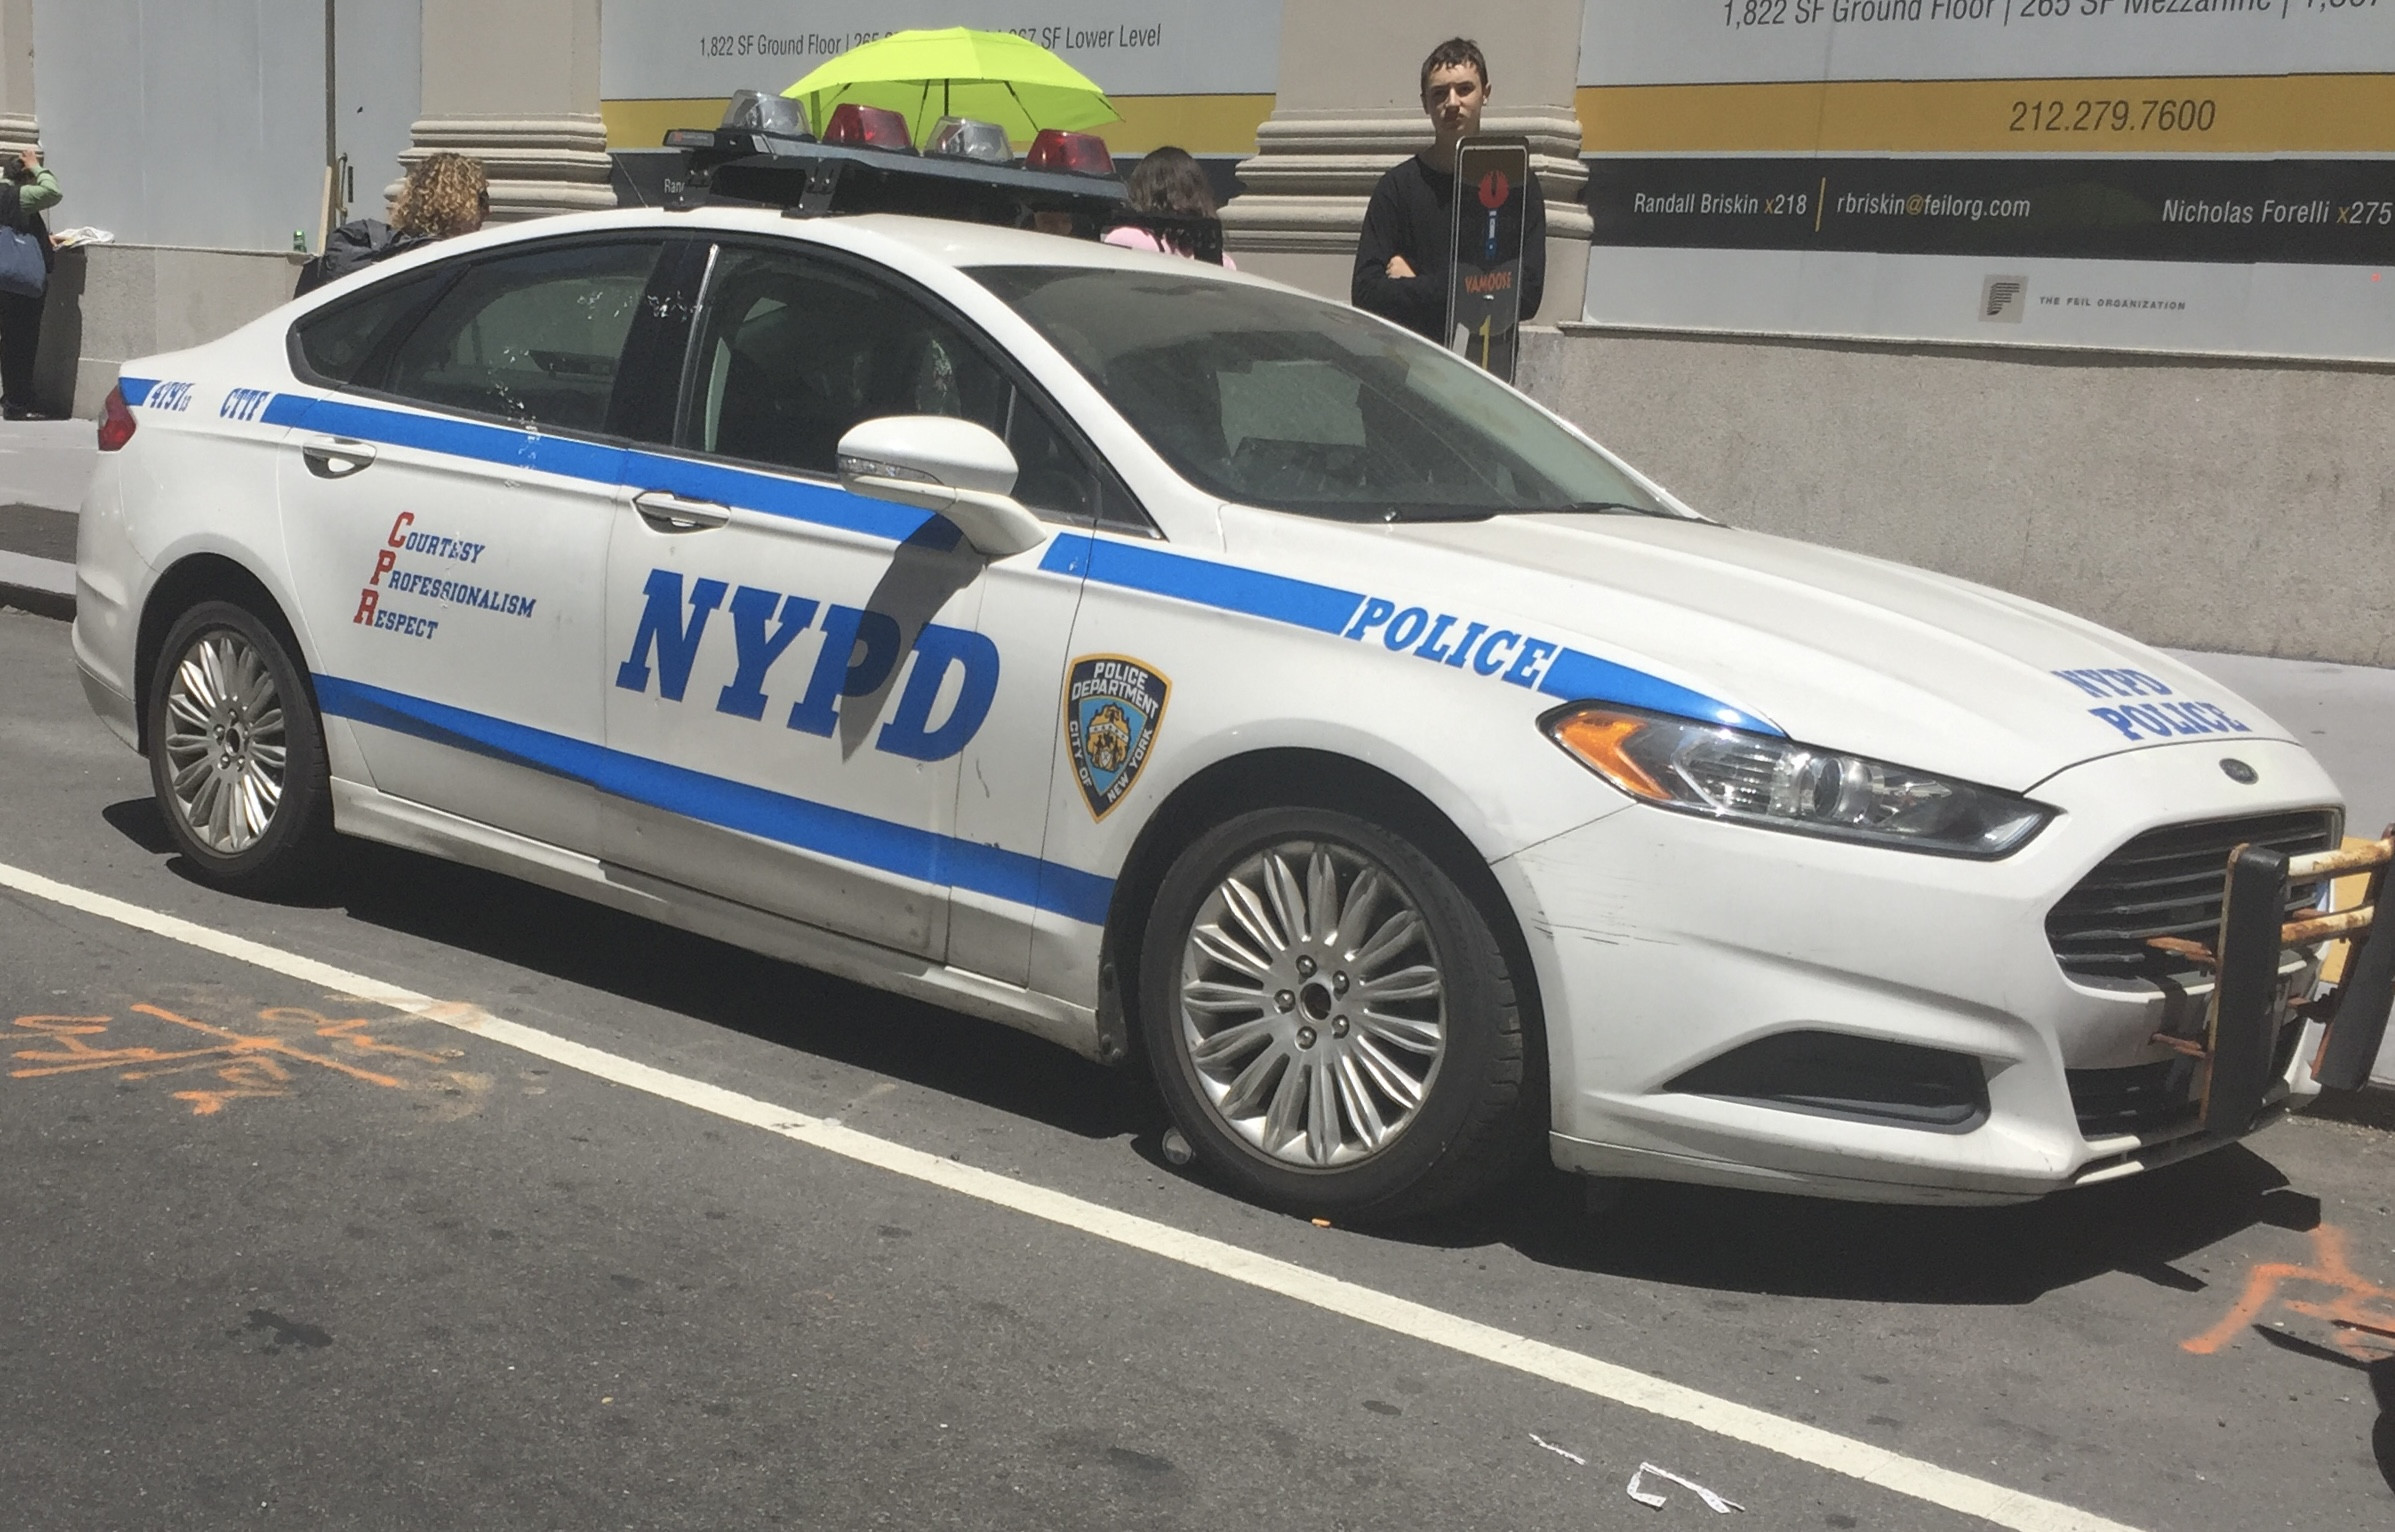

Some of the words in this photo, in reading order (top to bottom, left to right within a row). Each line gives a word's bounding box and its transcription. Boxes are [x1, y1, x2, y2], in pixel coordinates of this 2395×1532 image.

[1723, 0, 1785, 29] 1,822
[1795, 0, 1824, 24] SF
[1833, 0, 1921, 23] Ground
[1930, 0, 1994, 20] Floor
[700, 35, 734, 57] 1,822
[737, 34, 754, 55] SF
[757, 34, 804, 55] Ground
[808, 33, 842, 55] Floor
[1041, 26, 1061, 50] SF
[1065, 26, 1114, 49] Lower
[1119, 23, 1162, 48] Level
[2009, 100, 2216, 132] 212.279.7600
[1633, 192, 1695, 213] Randall
[1700, 193, 1758, 214] Briskin
[1764, 194, 1807, 215] x218
[1837, 193, 2031, 221] rbriskin@feilorg.com
[2162, 199, 2254, 224] Nicholas
[2261, 199, 2330, 224] Forelli
[2336, 201, 2393, 225] x275
[2039, 296, 2061, 306] THE
[2066, 297, 2091, 307] FEIL
[2097, 298, 2186, 311] ORGANIZATION
[387, 511, 486, 564] COURTESY
[370, 549, 537, 618] PROFESSIONALISM
[353, 588, 439, 640] RESPECT
[1345, 597, 1559, 690] POLICE
[615, 568, 1000, 762] NYPD
[1093, 662, 1149, 690] POLICE
[2049, 668, 2173, 699] NYPD
[1071, 679, 1159, 719] DEPARTMENT
[2087, 700, 2253, 742] POLICE
[1069, 720, 1084, 760] CITY
[1079, 766, 1093, 788] OF
[1106, 771, 1129, 804] NEW
[1129, 728, 1153, 769] YORK
